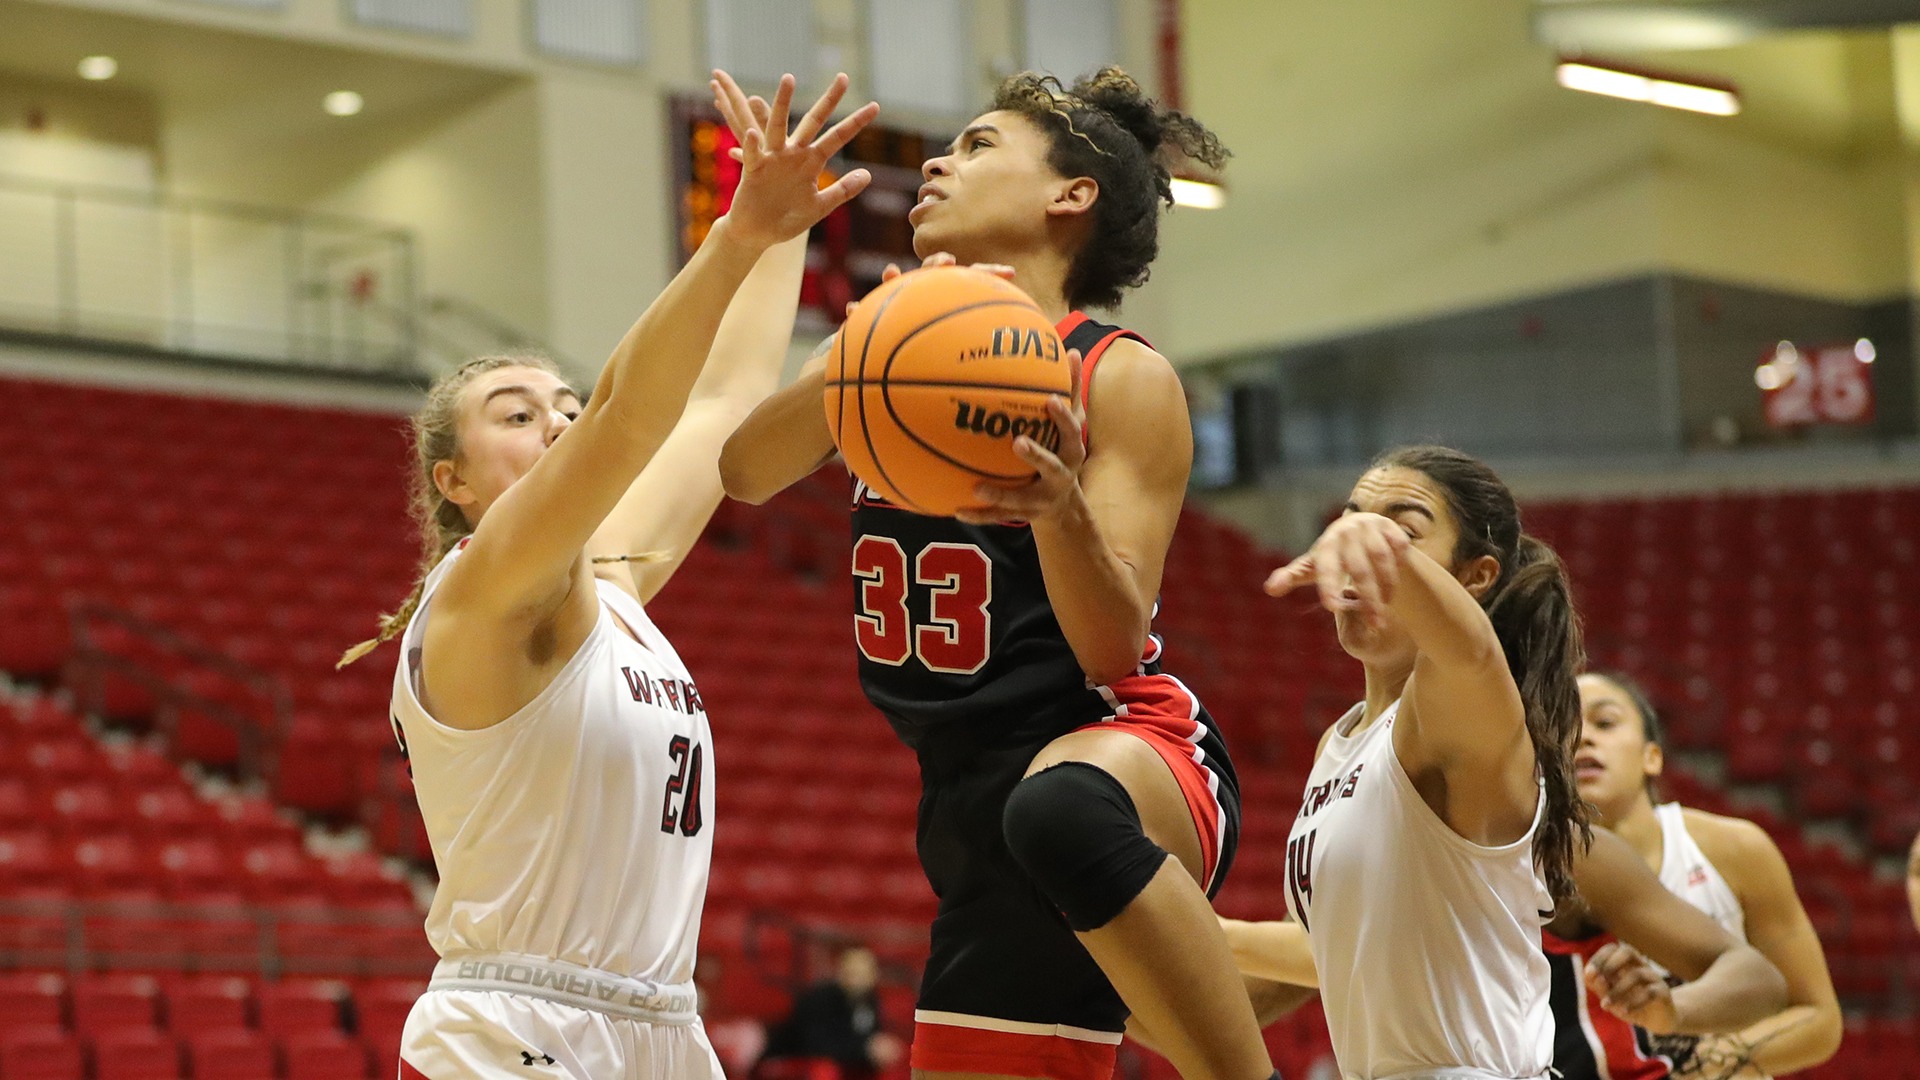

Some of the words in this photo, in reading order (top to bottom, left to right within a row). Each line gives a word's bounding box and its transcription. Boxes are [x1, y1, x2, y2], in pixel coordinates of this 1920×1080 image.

[991, 326, 1060, 363] EVO
[852, 534, 992, 675] 33
[661, 734, 703, 837] 20
[1288, 828, 1317, 934] 14
[458, 960, 618, 1001] ARMOUR
